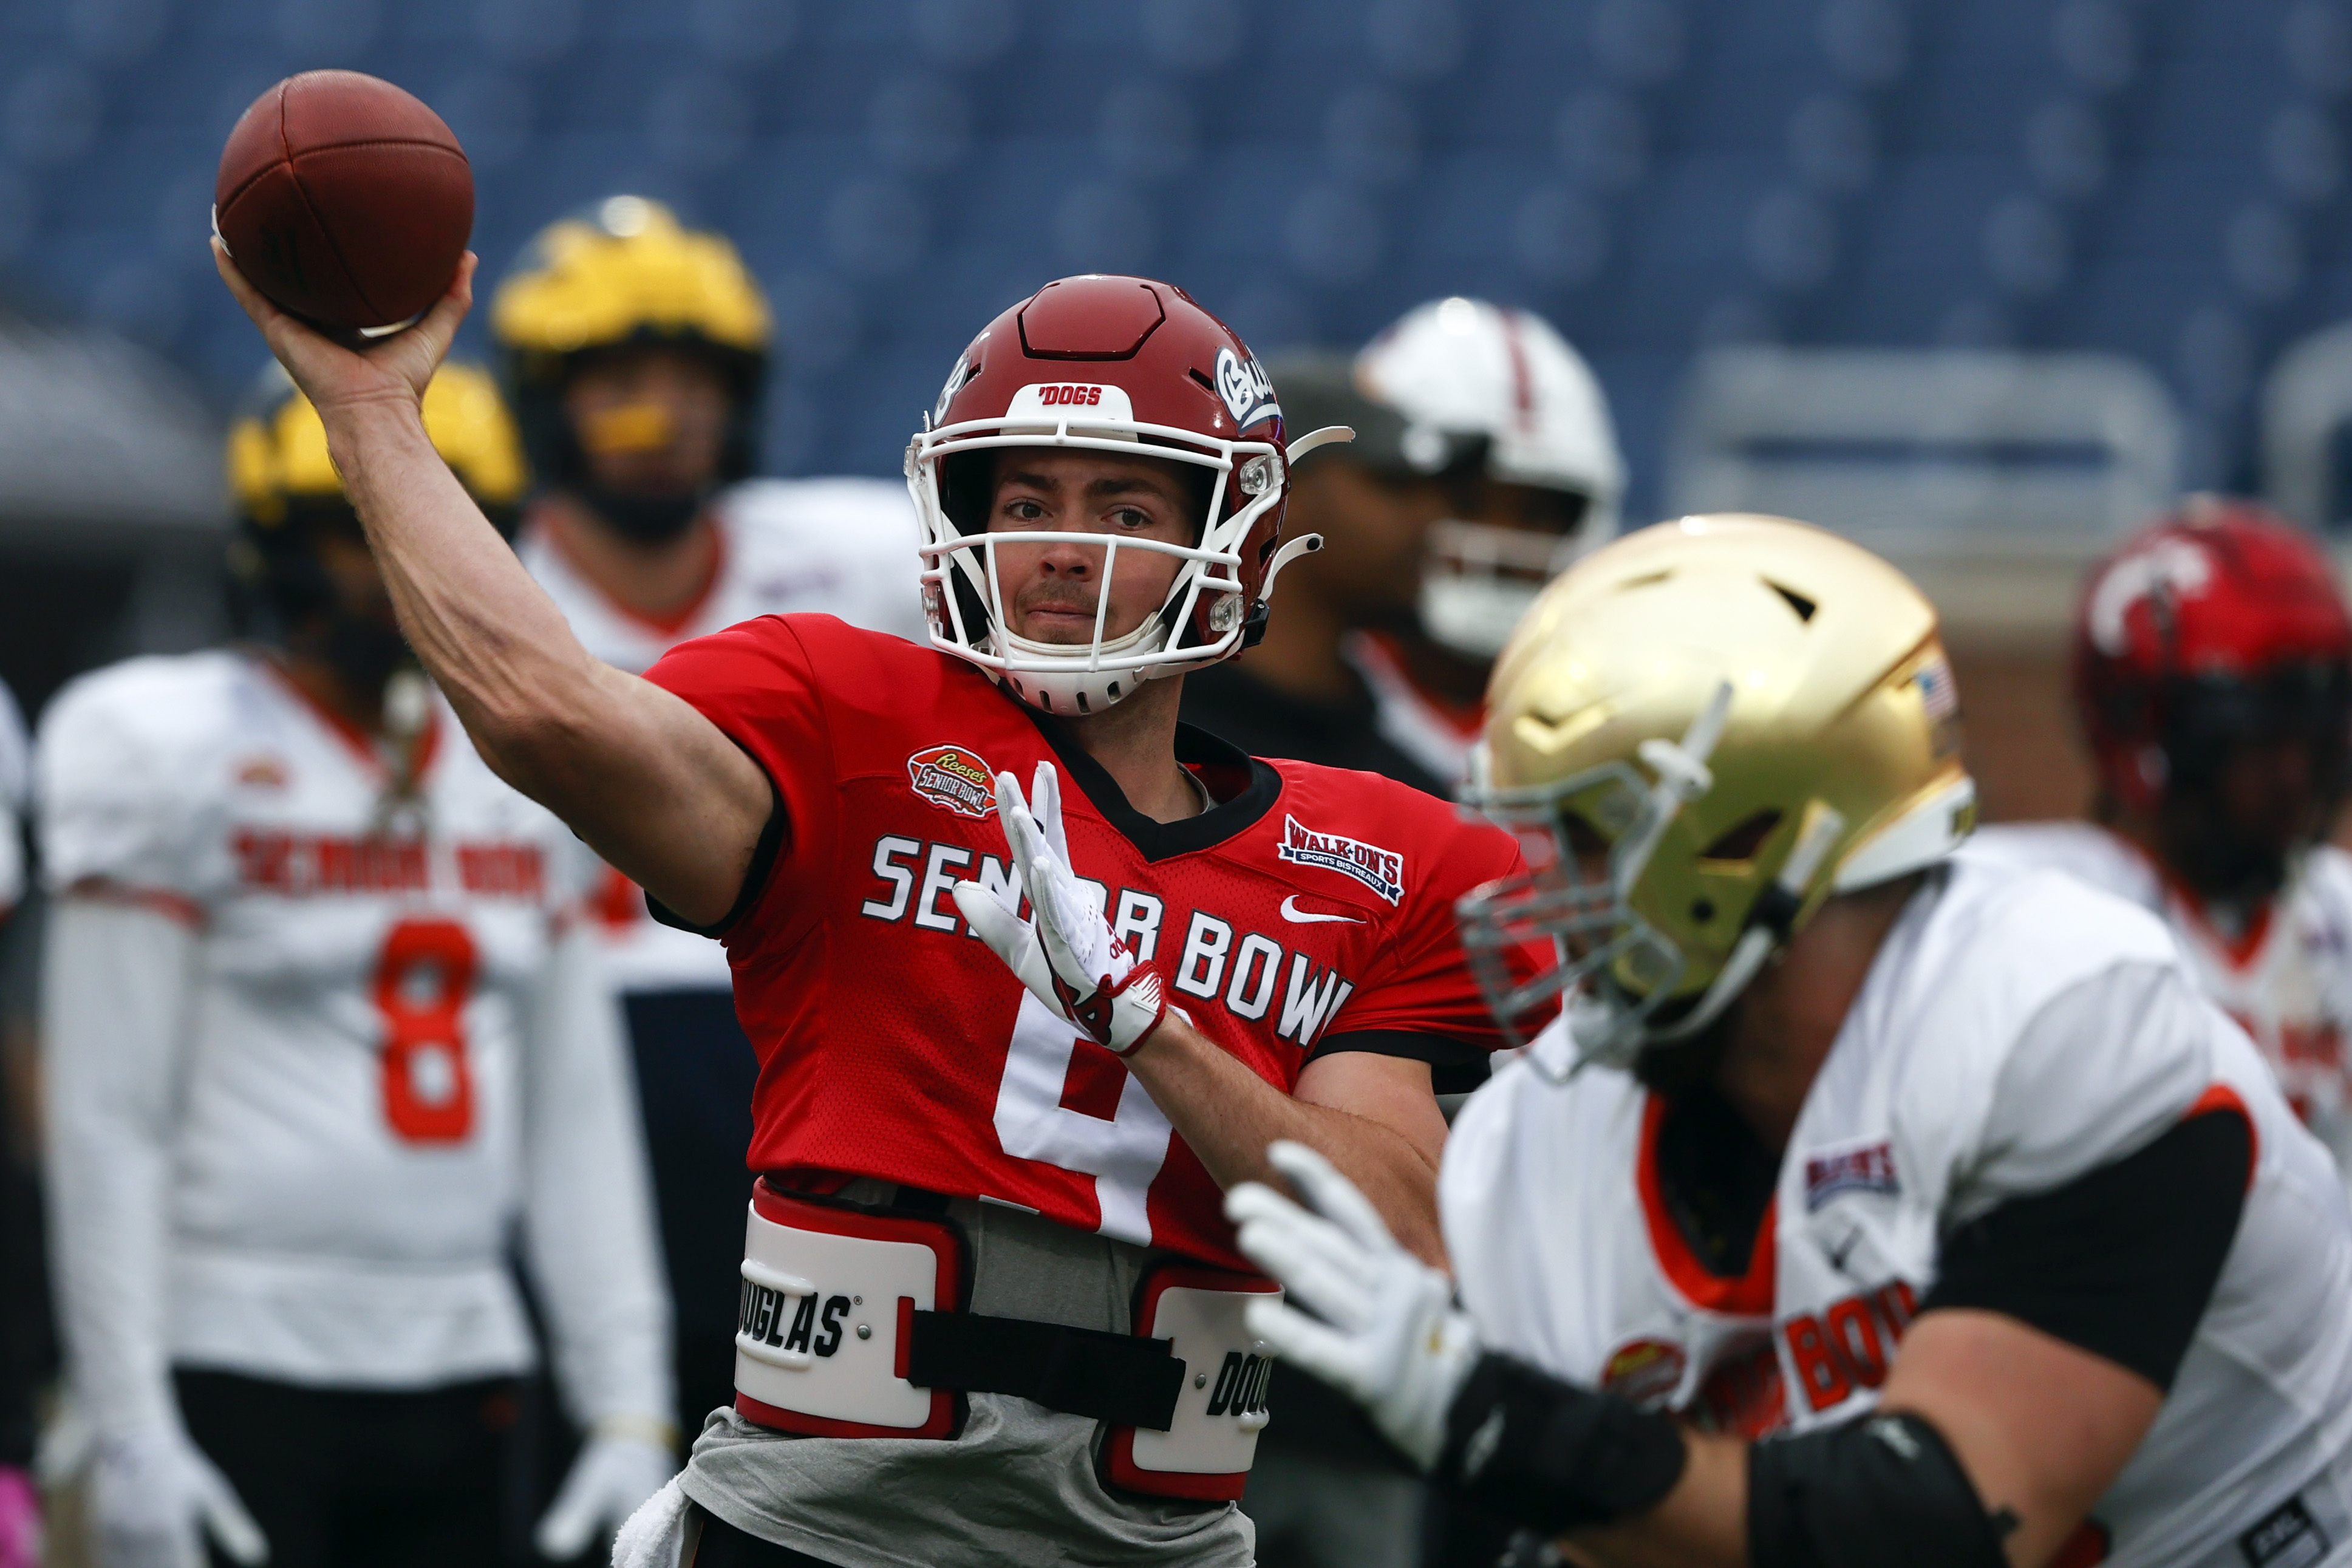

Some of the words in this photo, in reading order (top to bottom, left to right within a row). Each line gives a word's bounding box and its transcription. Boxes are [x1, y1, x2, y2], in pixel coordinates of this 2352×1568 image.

[1038, 386, 1102, 406] 'DOGS
[935, 753, 987, 783] Reese's
[918, 768, 958, 796] SENIOR
[957, 783, 986, 811] BOWL
[1300, 853, 1335, 865] SPORTS
[1336, 860, 1383, 890] BISTREAUX
[861, 834, 1165, 968] SENR
[373, 917, 477, 1144] 8
